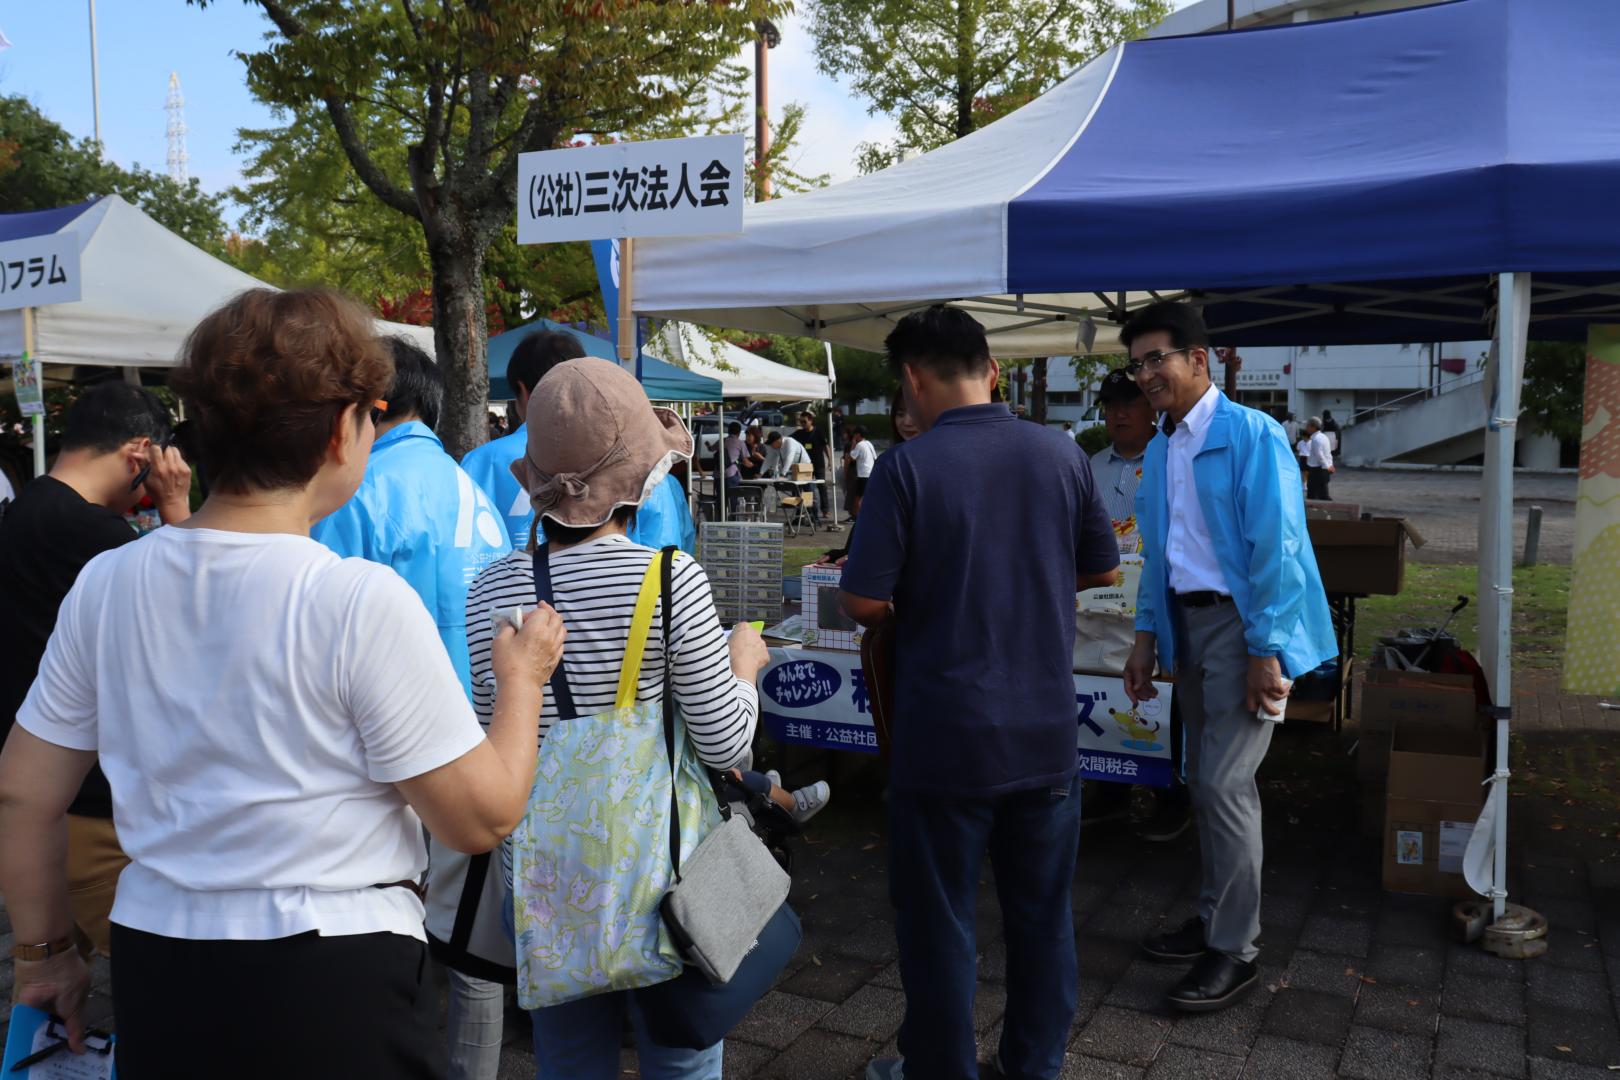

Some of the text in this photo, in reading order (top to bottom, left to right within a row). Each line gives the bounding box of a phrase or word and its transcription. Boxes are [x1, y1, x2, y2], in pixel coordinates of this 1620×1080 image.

[529, 159, 731, 219] (公社)三次法人会
[778, 662, 816, 683] みんなで
